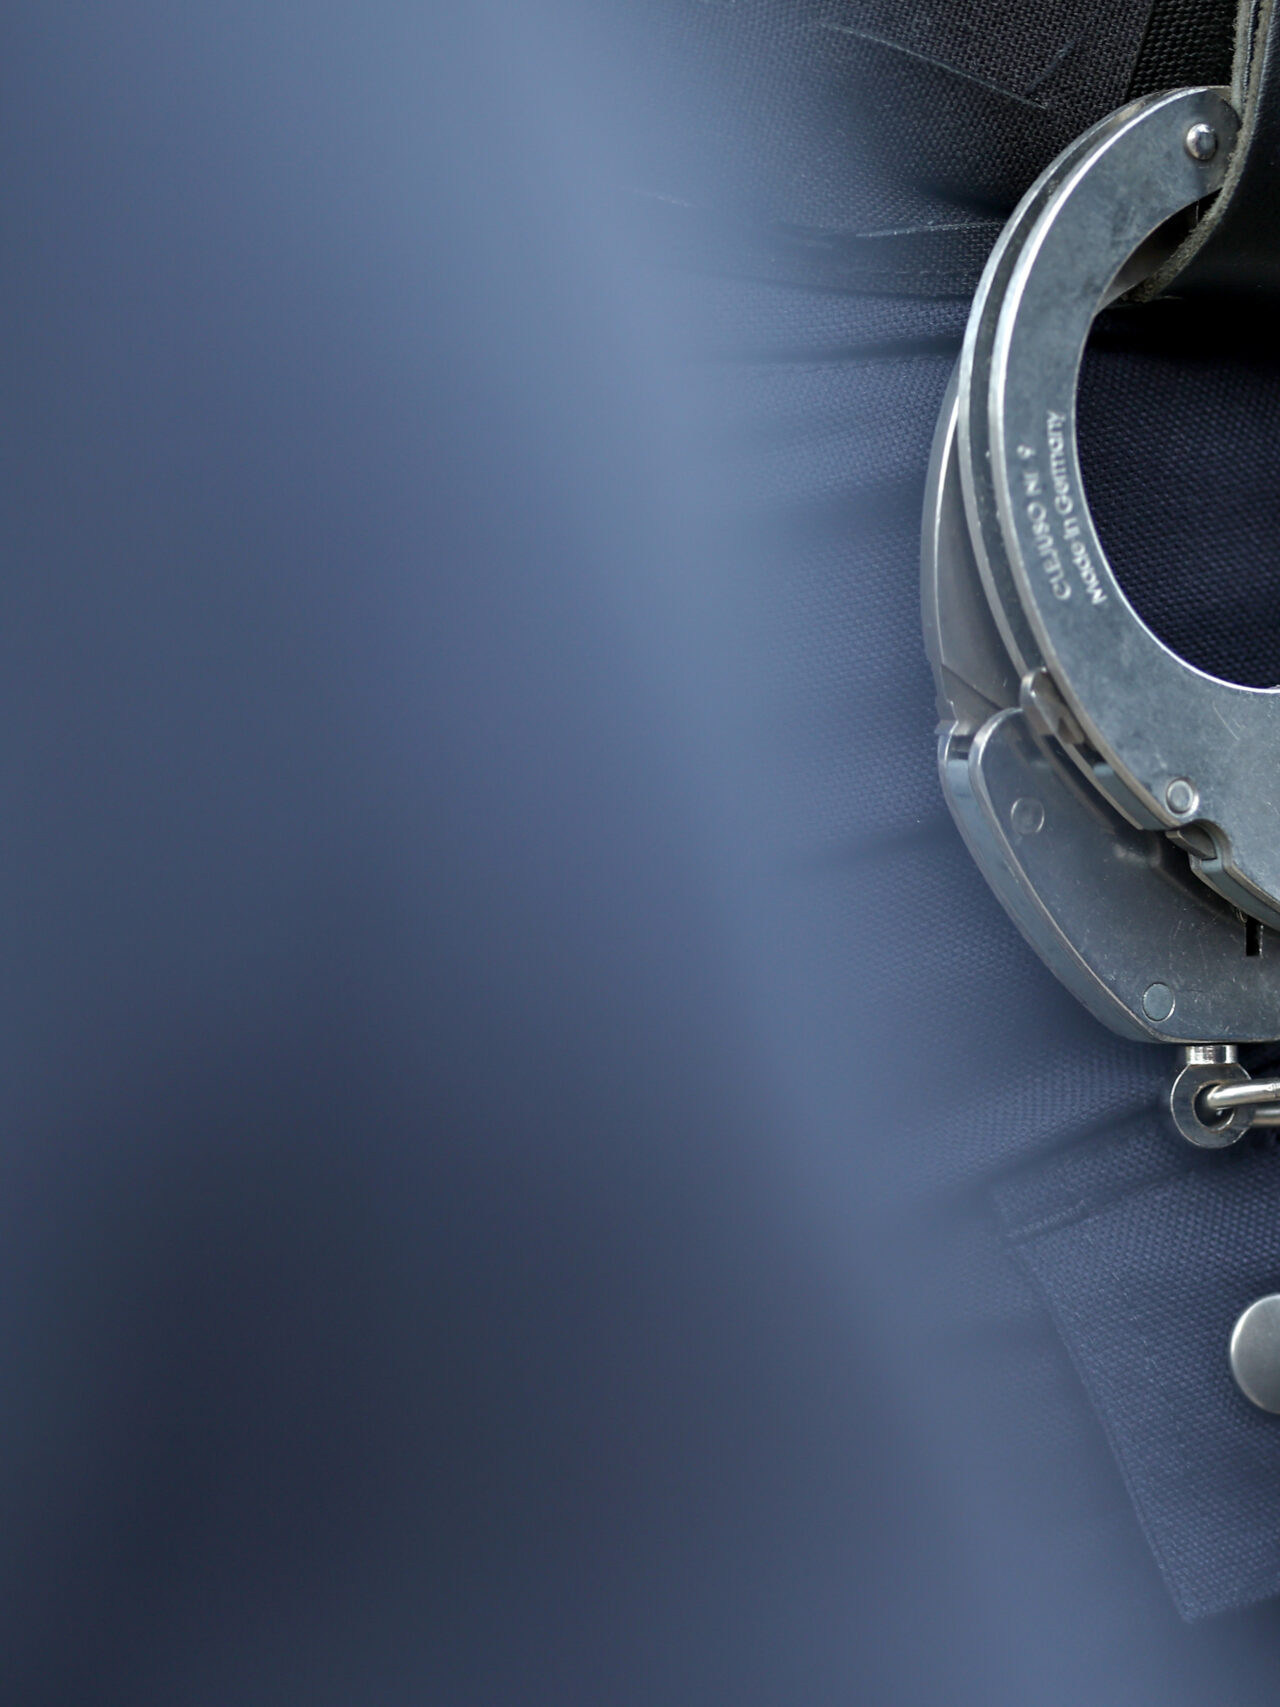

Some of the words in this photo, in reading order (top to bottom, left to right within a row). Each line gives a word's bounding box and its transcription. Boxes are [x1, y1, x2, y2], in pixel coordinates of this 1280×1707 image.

[1046, 410, 1074, 516] Germany
[1027, 501, 1072, 600] CLEJUSO
[1070, 540, 1108, 605] Made
